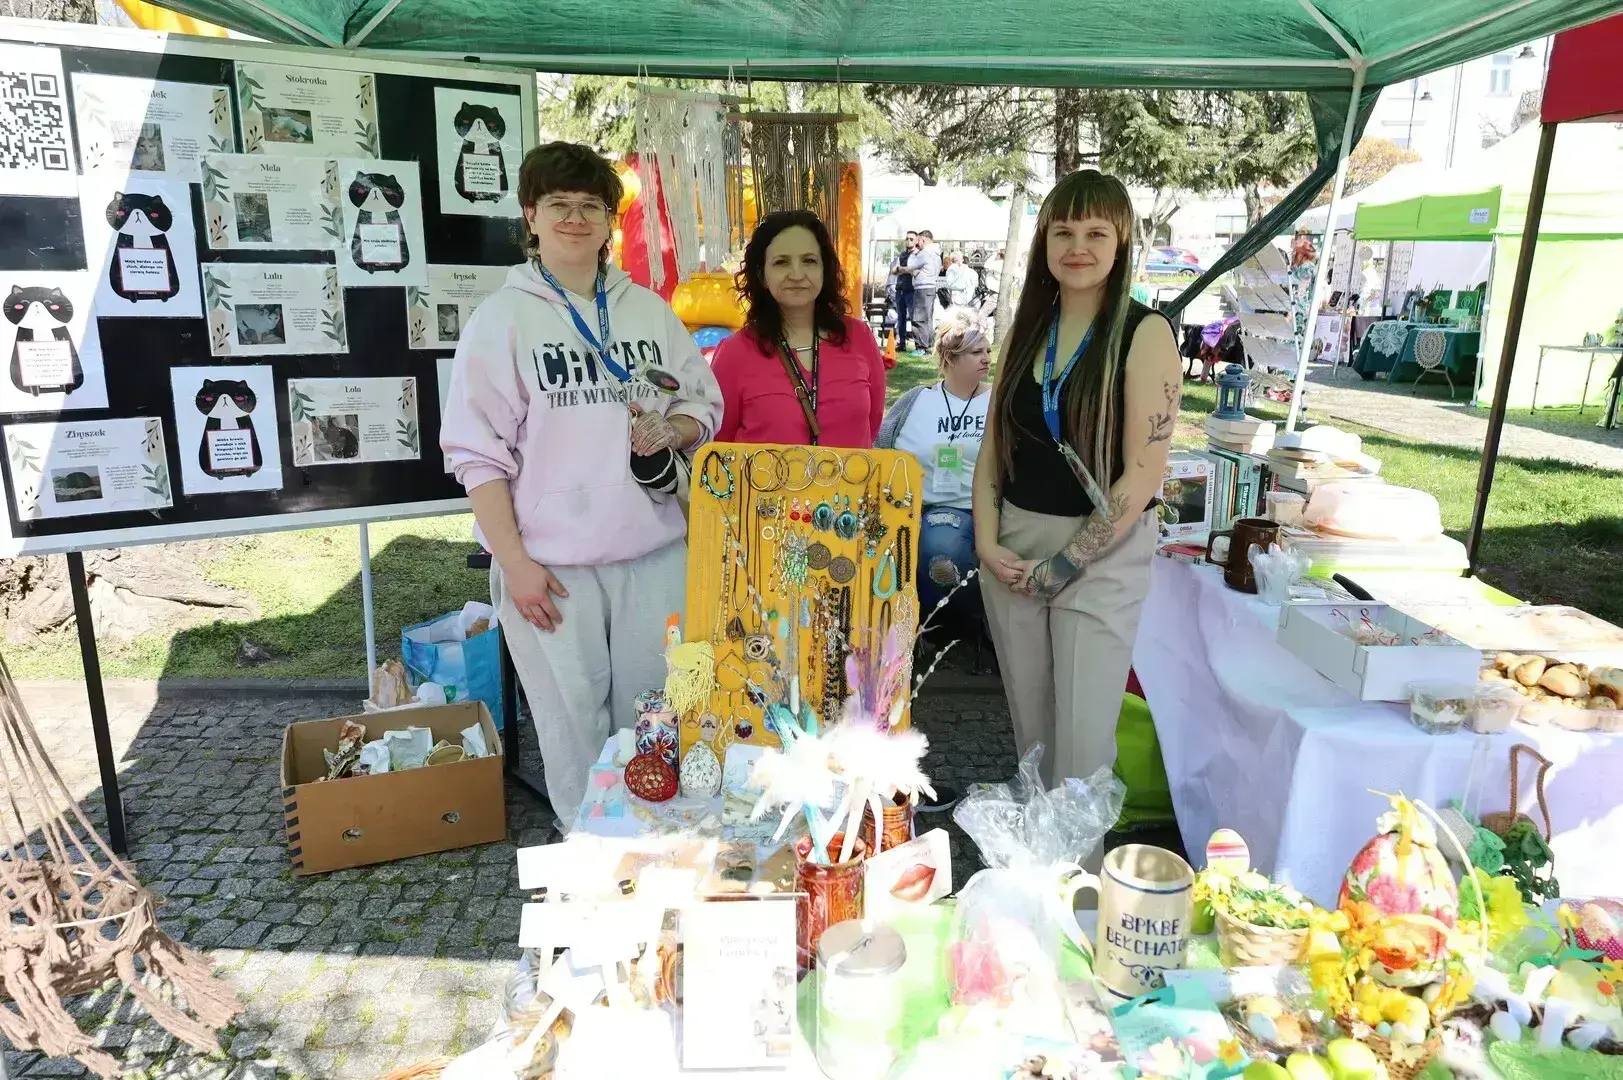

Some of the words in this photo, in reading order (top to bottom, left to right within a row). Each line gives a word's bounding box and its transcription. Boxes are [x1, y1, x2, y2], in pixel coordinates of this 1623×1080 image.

[286, 74, 328, 86] Stokrotka
[260, 164, 281, 172] Mela
[454, 273, 476, 281] Irysek
[547, 390, 578, 409] THE
[937, 415, 985, 434] NOPE
[66, 430, 106, 440] Zbyszek
[1120, 912, 1180, 936] BPKBE
